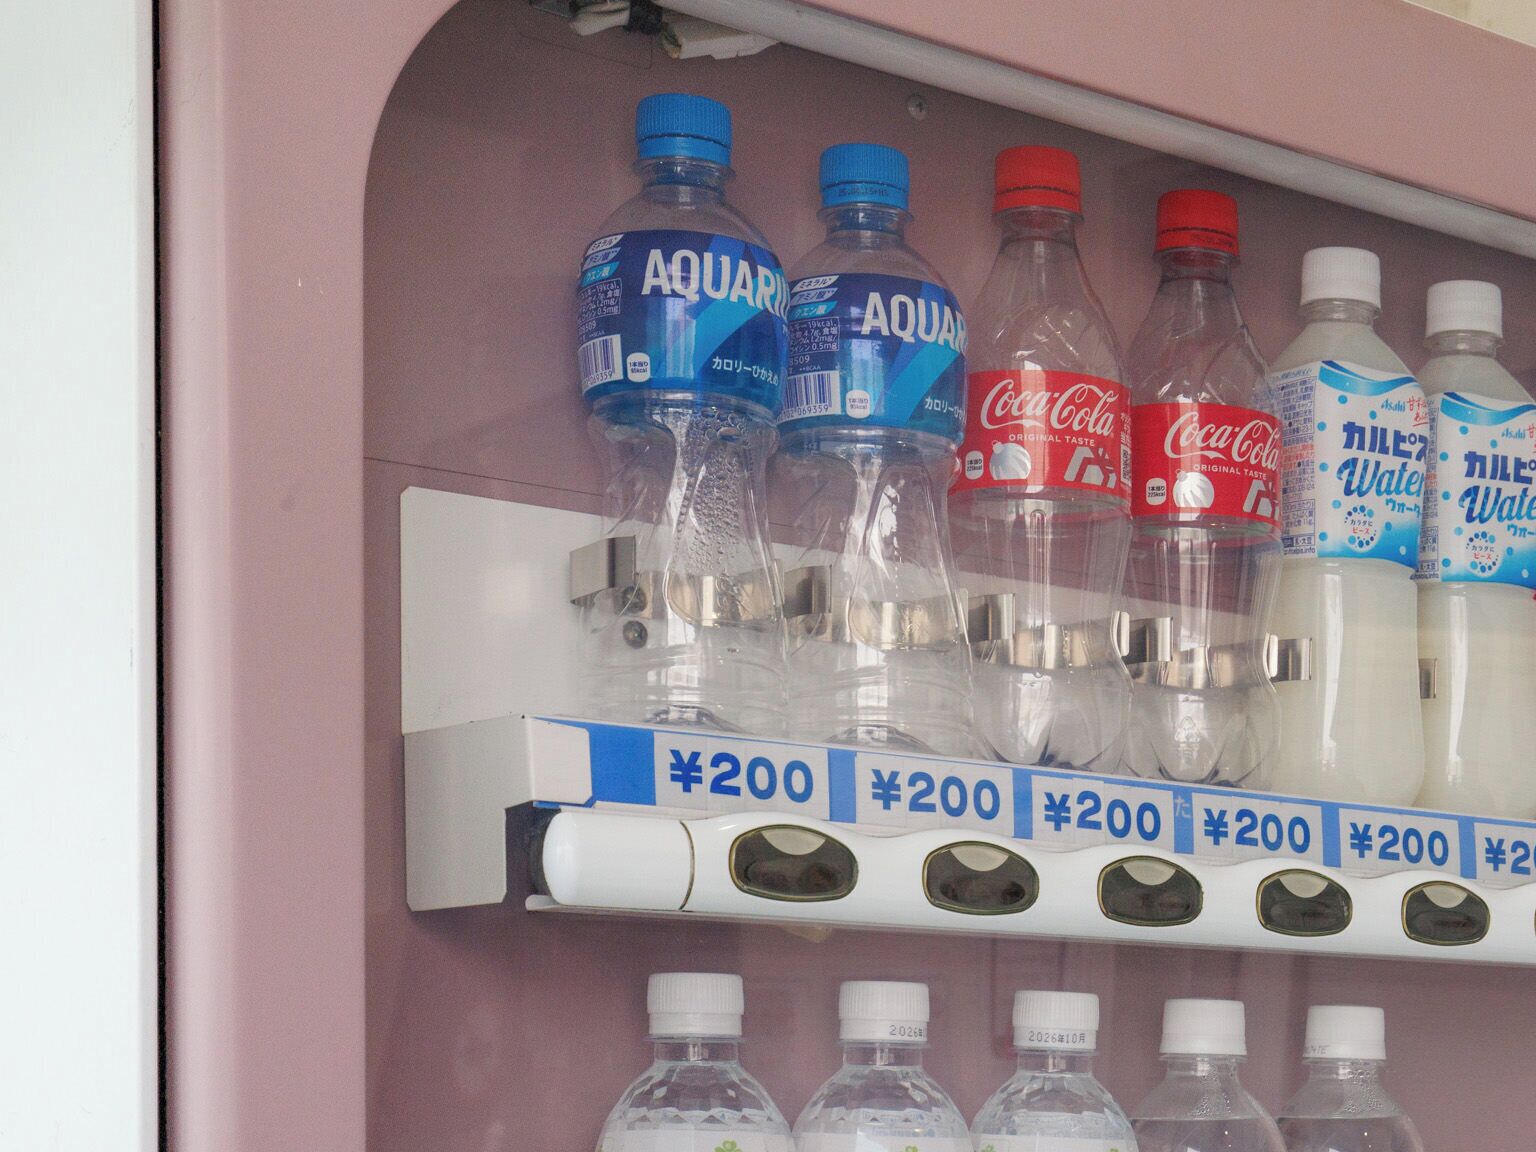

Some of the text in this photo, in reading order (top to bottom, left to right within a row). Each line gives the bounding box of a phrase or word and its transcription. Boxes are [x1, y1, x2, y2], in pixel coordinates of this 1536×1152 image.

[712, 355, 779, 386] カロリーひかえめ
[980, 378, 1120, 437] Coca-Cola
[1008, 433, 1096, 447] ORIGINAL TASTE
[1193, 463, 1267, 480] ORIGINAL TASTE
[1350, 519, 1373, 528] カラダに
[1352, 527, 1370, 535] ピース
[1471, 544, 1495, 553] カラダに
[1473, 552, 1492, 560] ピース
[669, 749, 815, 803] ¥200
[871, 769, 1000, 820] ¥200
[1044, 790, 1162, 841] ¥200
[1203, 808, 1312, 855] ¥200
[1349, 822, 1450, 867] ¥200
[1028, 1030, 1086, 1044] 2026年10月
